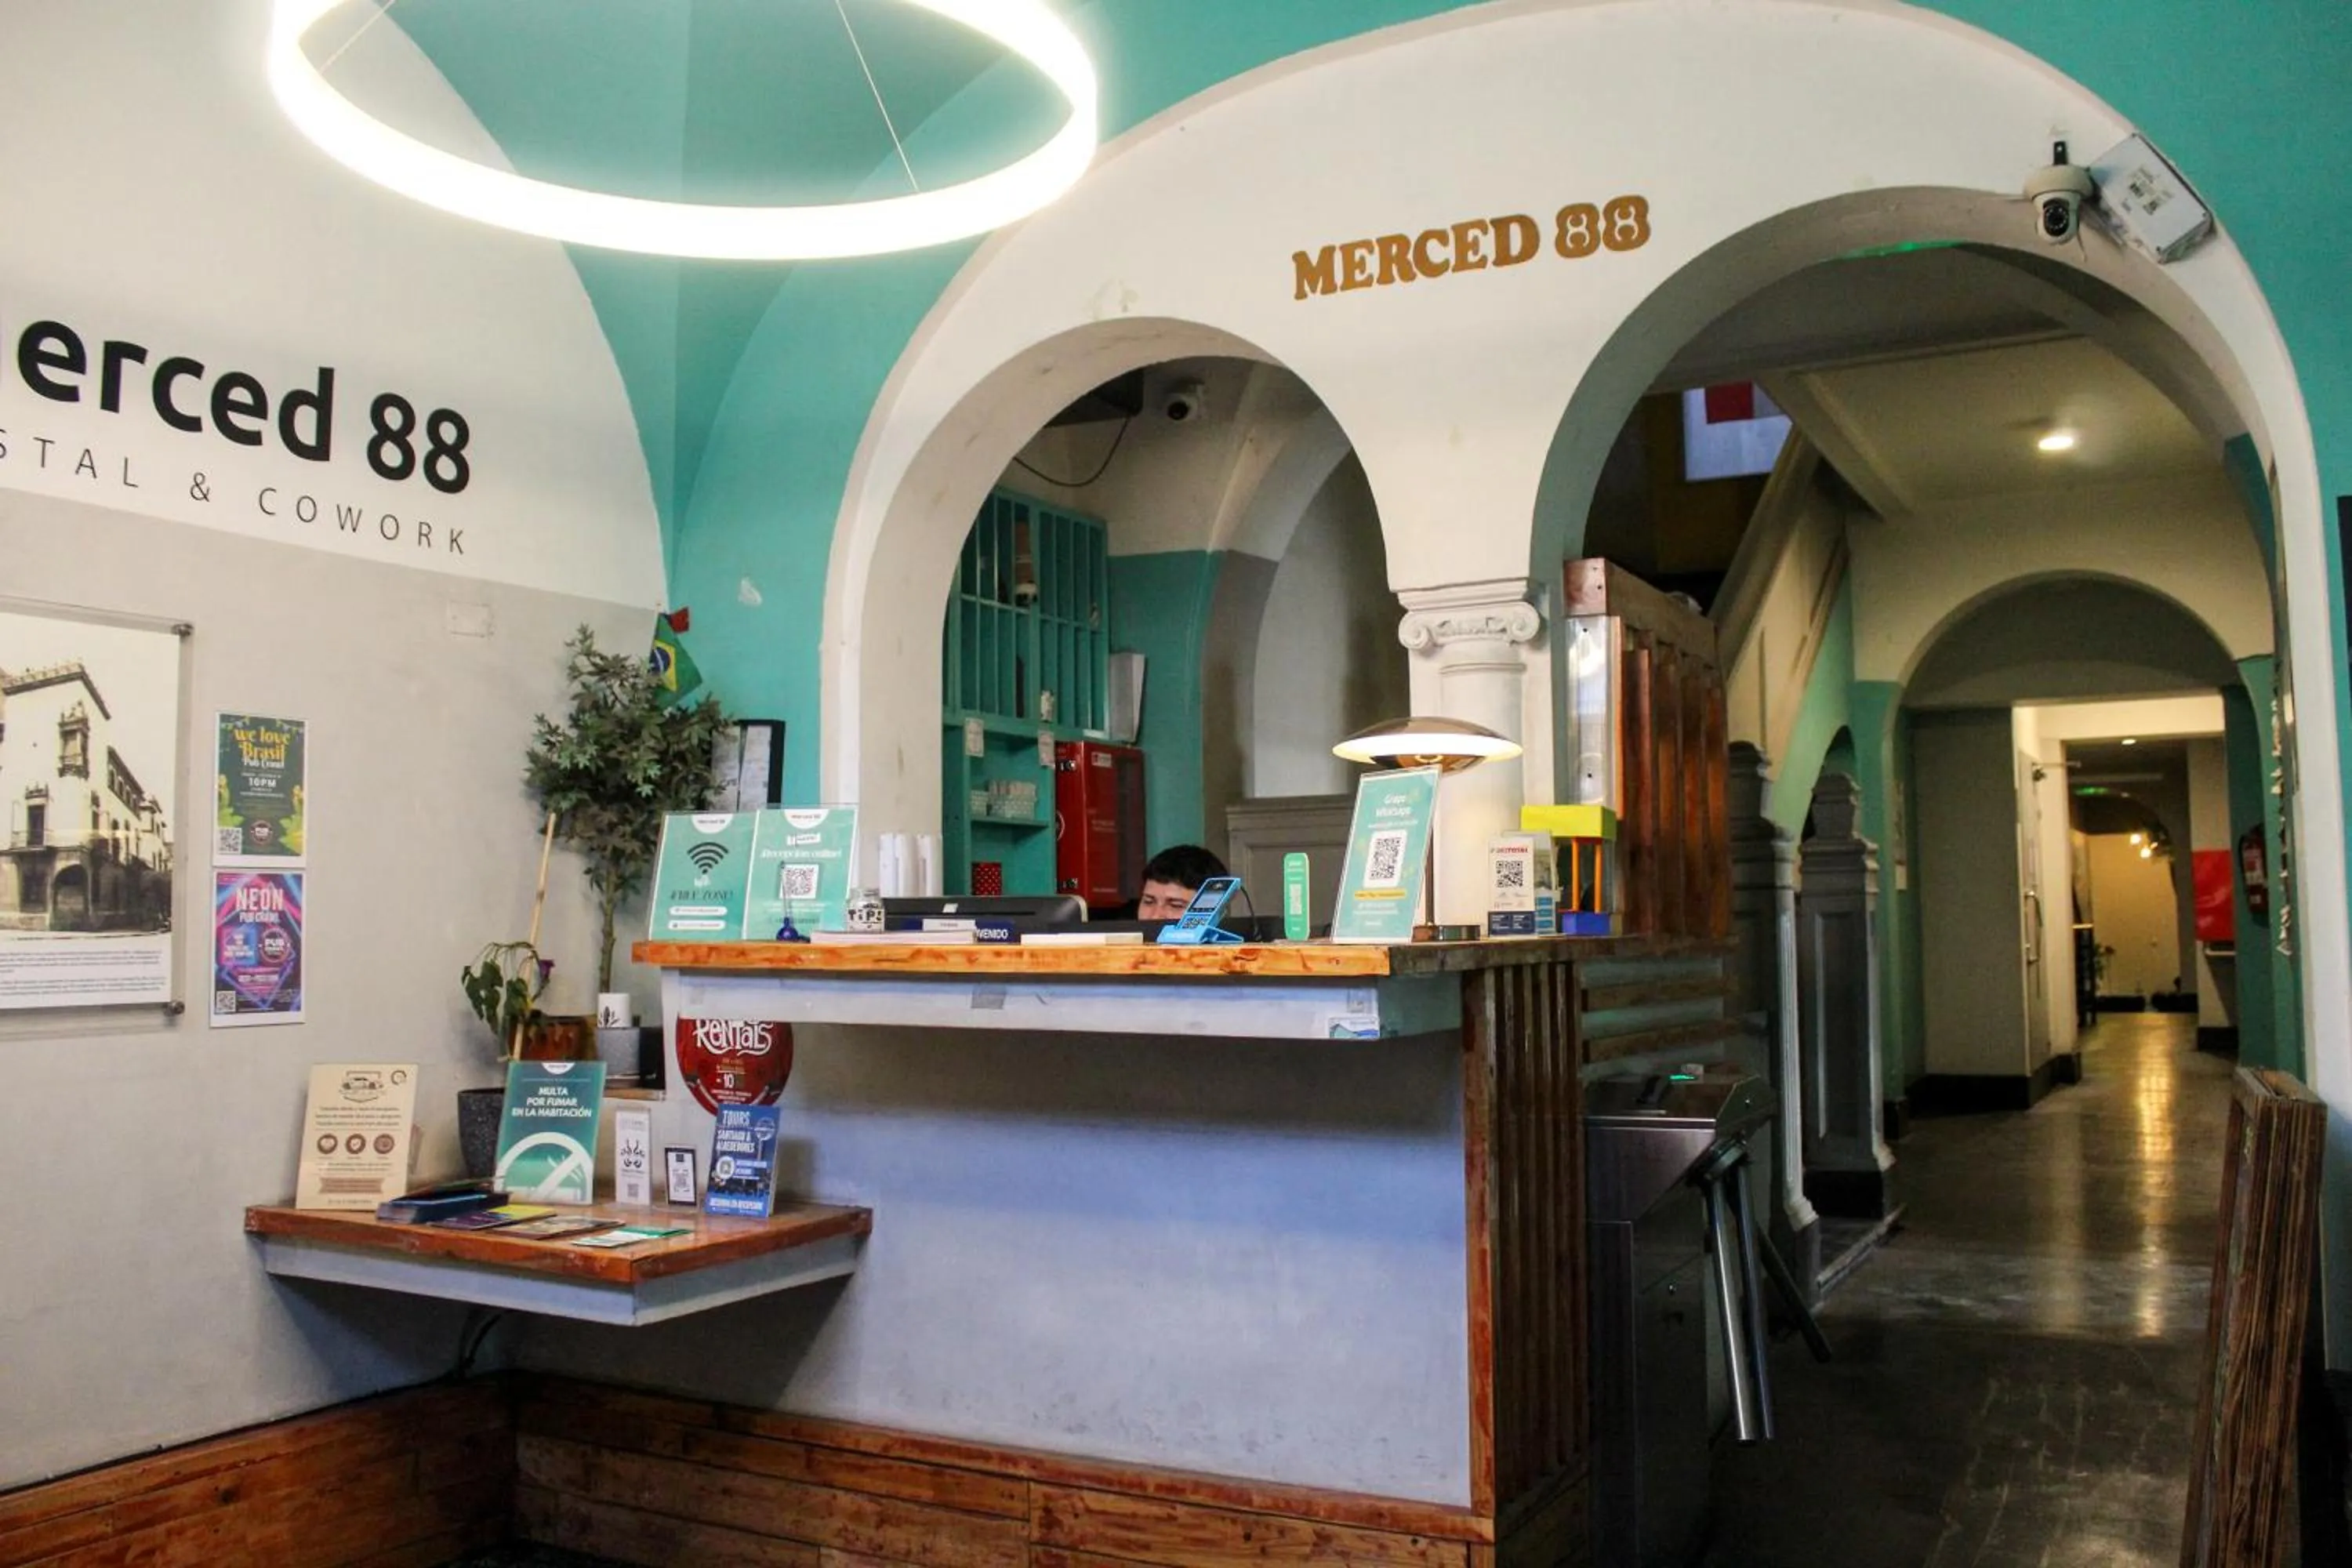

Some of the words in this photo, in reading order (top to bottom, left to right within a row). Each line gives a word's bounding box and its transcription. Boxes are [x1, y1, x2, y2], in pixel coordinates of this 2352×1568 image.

[1291, 213, 1541, 300] MERCED
[1555, 194, 1652, 259] 88
[366, 392, 470, 494] 88
[190, 472, 211, 503] &
[258, 488, 465, 555] COWORK
[236, 887, 285, 911] NEON
[526, 1098, 546, 1106] POR
[546, 1098, 578, 1106] FUMAR
[538, 1087, 568, 1095] MULTA
[511, 1107, 524, 1116] EN
[524, 1107, 537, 1116] LA
